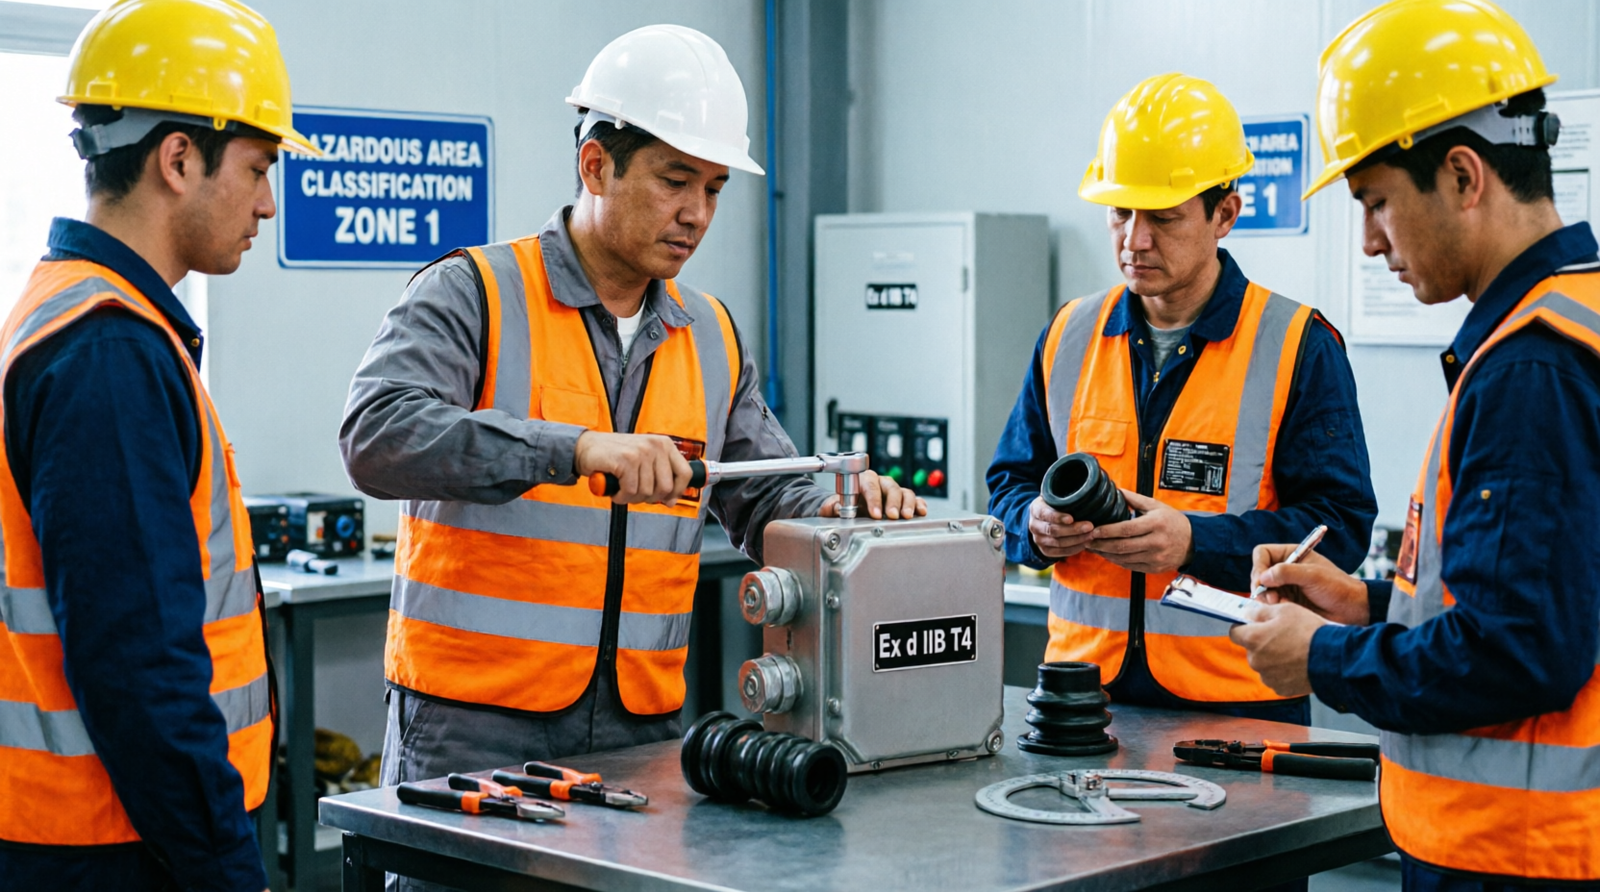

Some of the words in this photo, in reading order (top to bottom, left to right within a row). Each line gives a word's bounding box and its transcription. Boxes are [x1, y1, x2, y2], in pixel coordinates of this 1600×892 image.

[290, 133, 423, 165] AZARDOUS
[426, 139, 483, 167] AREA
[301, 169, 473, 201] CLASSIFICATION
[1262, 182, 1277, 217] 1
[335, 206, 417, 244] ZONE
[424, 208, 440, 245] 1
[879, 632, 902, 659] Ex
[906, 631, 917, 656] d
[923, 628, 946, 655] IIB
[950, 626, 972, 652] T4
